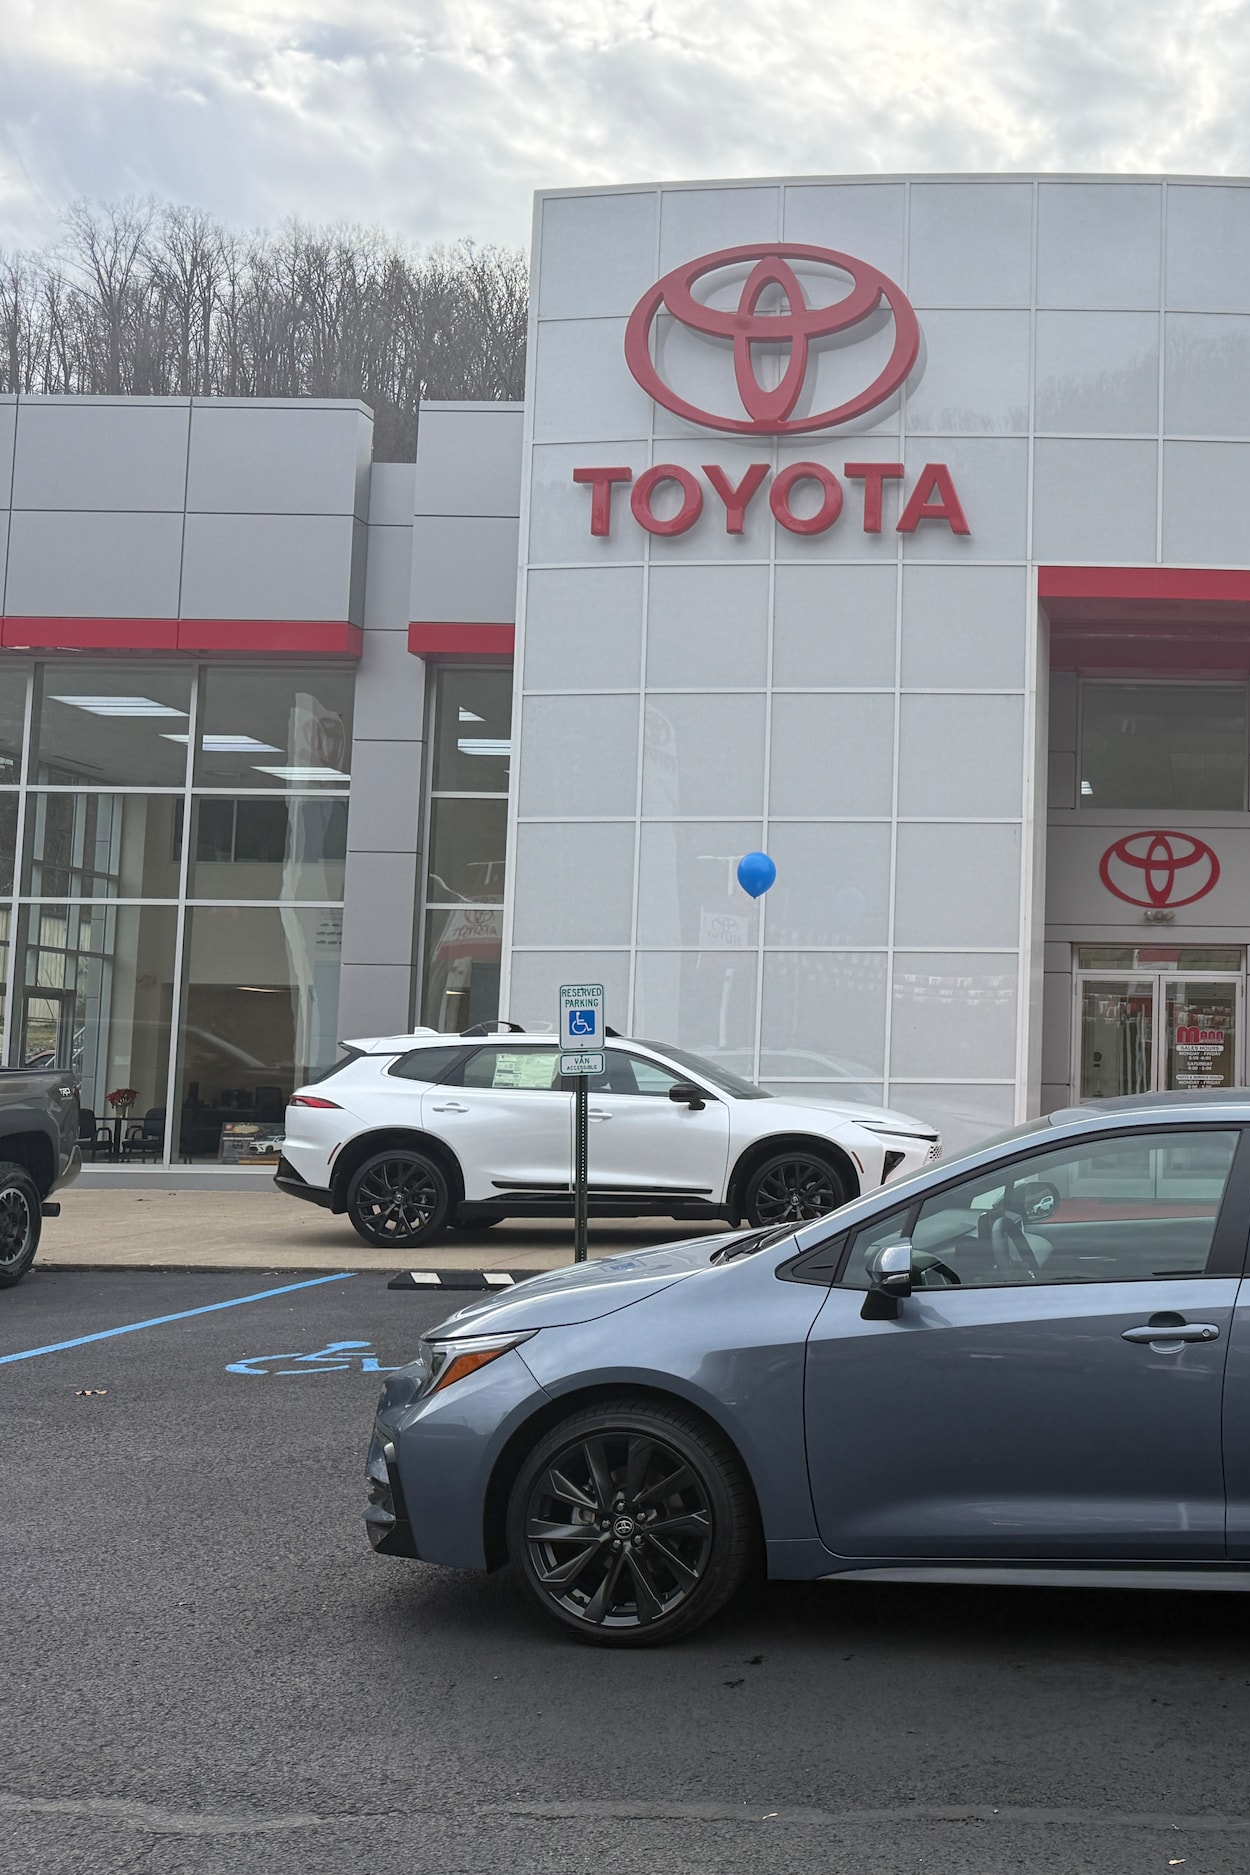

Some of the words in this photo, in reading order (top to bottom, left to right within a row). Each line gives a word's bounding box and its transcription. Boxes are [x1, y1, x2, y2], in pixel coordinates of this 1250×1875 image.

[573, 461, 971, 537] TOYOTA
[561, 987, 602, 997] RESERVED
[565, 998, 599, 1008] PARKING
[574, 1057, 590, 1065] VAN
